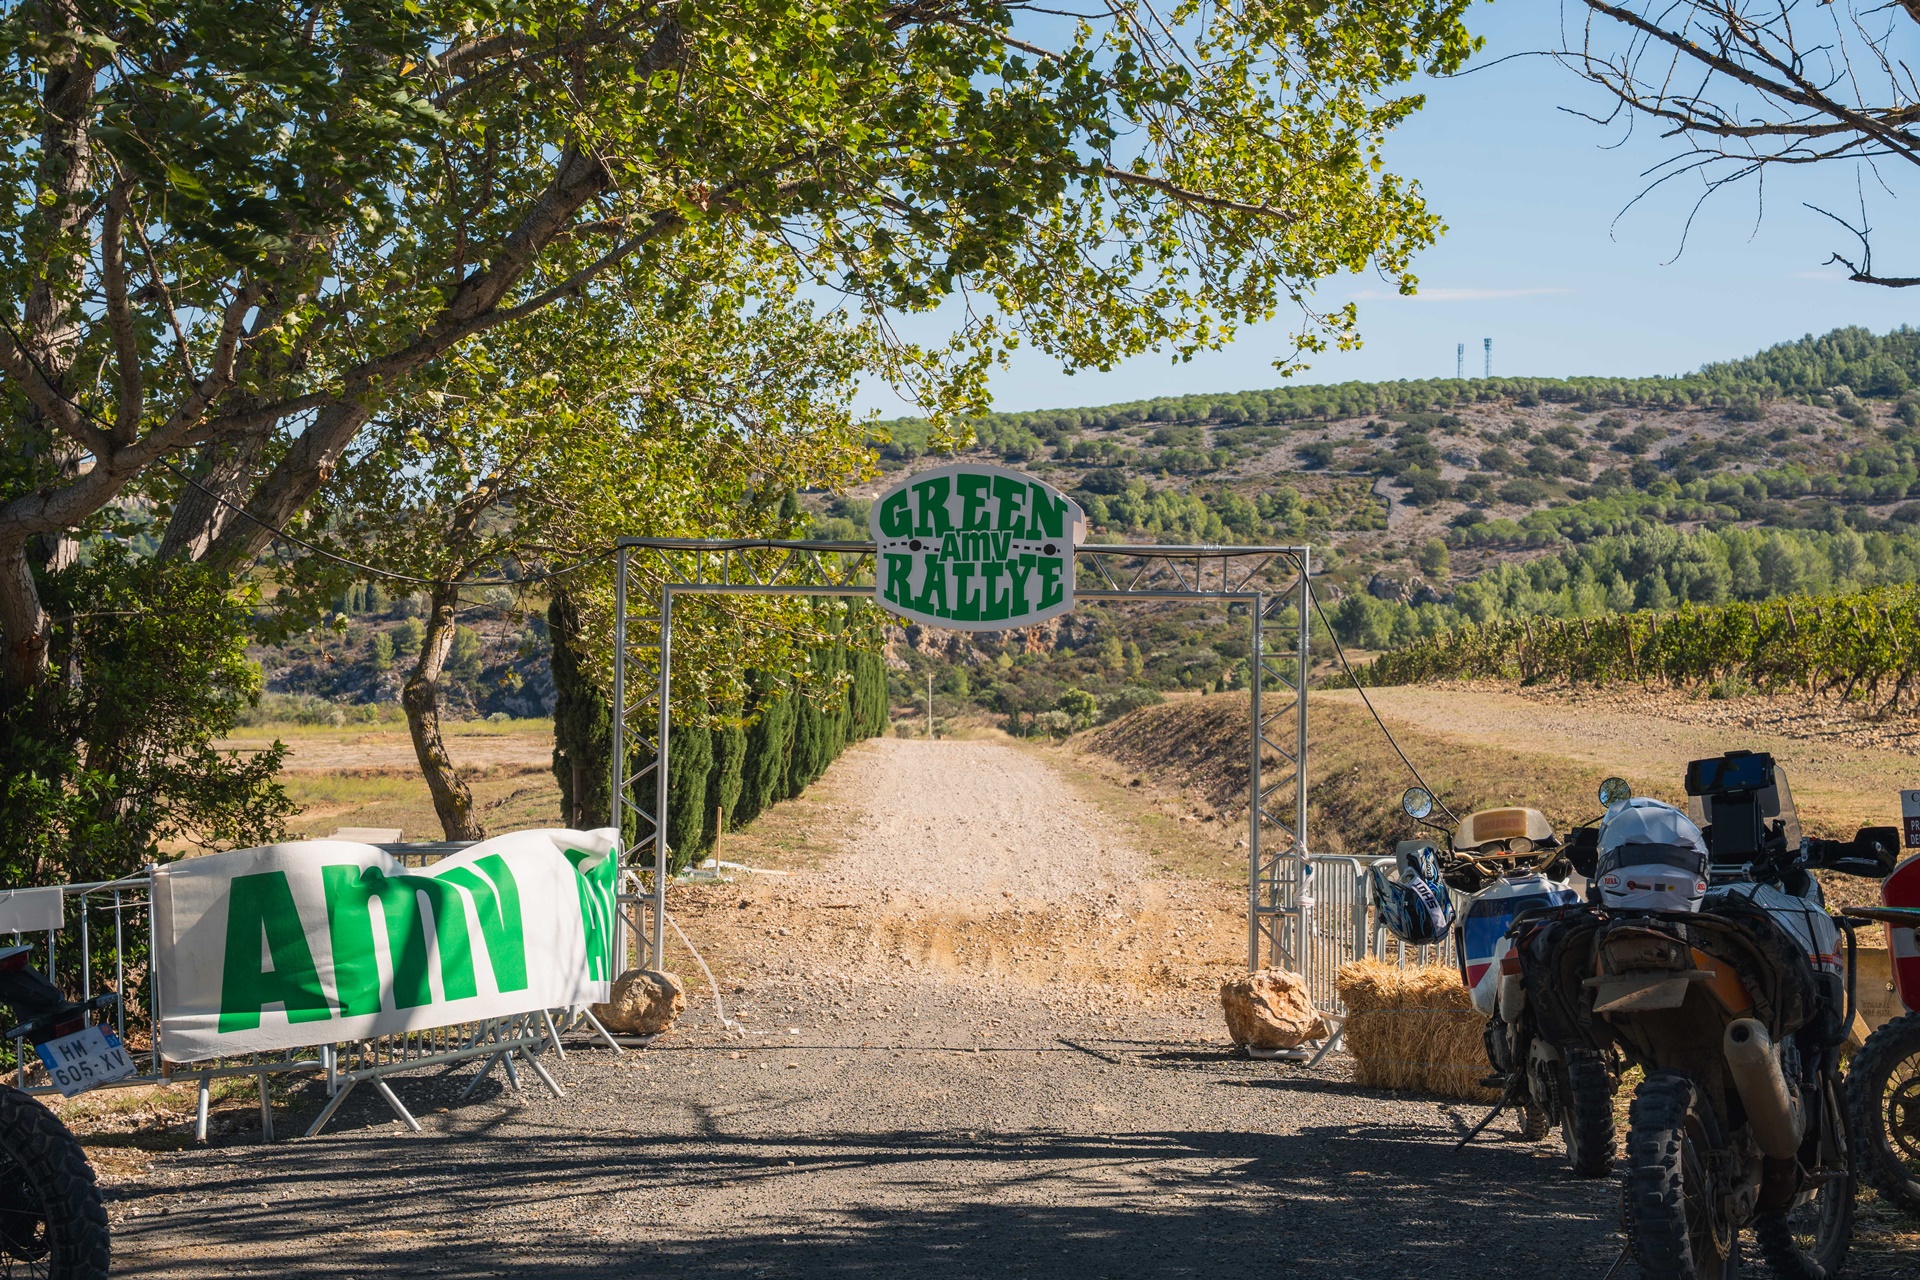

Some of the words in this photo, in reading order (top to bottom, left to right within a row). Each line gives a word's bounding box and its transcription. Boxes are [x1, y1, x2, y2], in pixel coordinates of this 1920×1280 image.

[879, 473, 1069, 540] GREEN
[883, 553, 1063, 622] RALLYE
[1412, 882, 1438, 909] SHOT
[1604, 877, 1618, 885] BELL
[108, 1037, 119, 1046] 31
[55, 1049, 125, 1086] 605-XV
